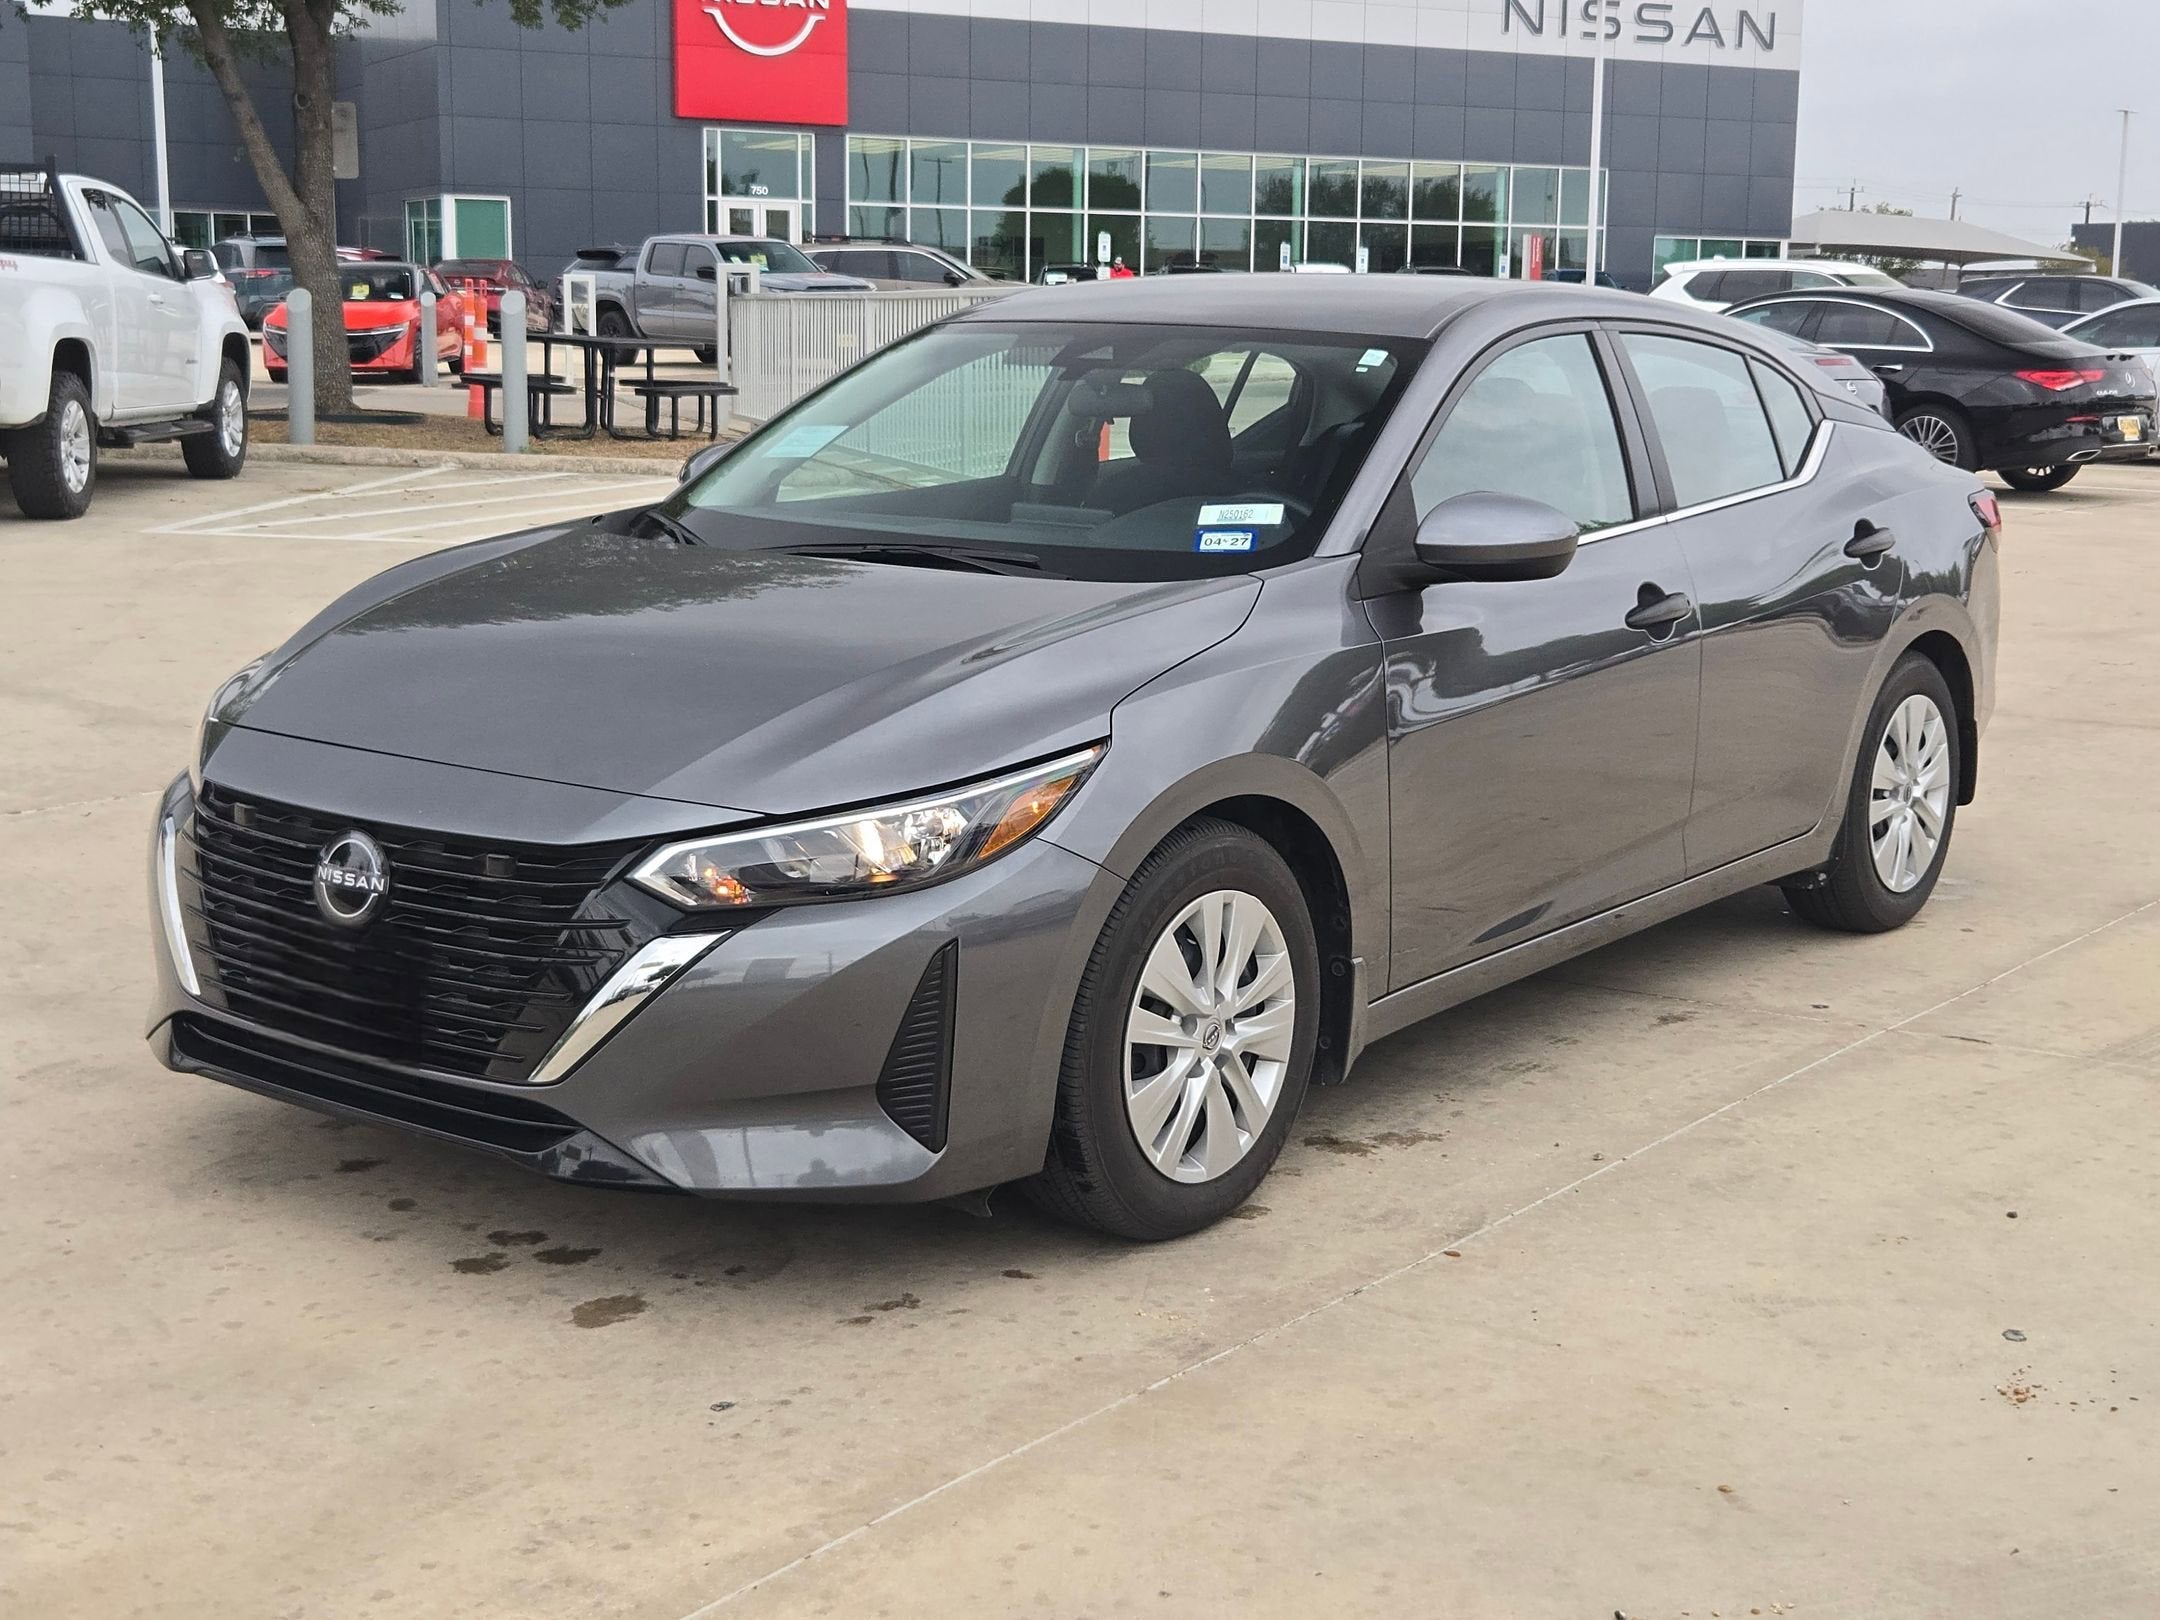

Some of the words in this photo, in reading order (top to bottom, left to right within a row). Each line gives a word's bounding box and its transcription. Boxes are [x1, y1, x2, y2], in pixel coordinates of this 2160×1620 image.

[1502, 0, 1776, 51] NISSAN
[750, 185, 769, 195] 750
[318, 865, 385, 892] NISSAN
